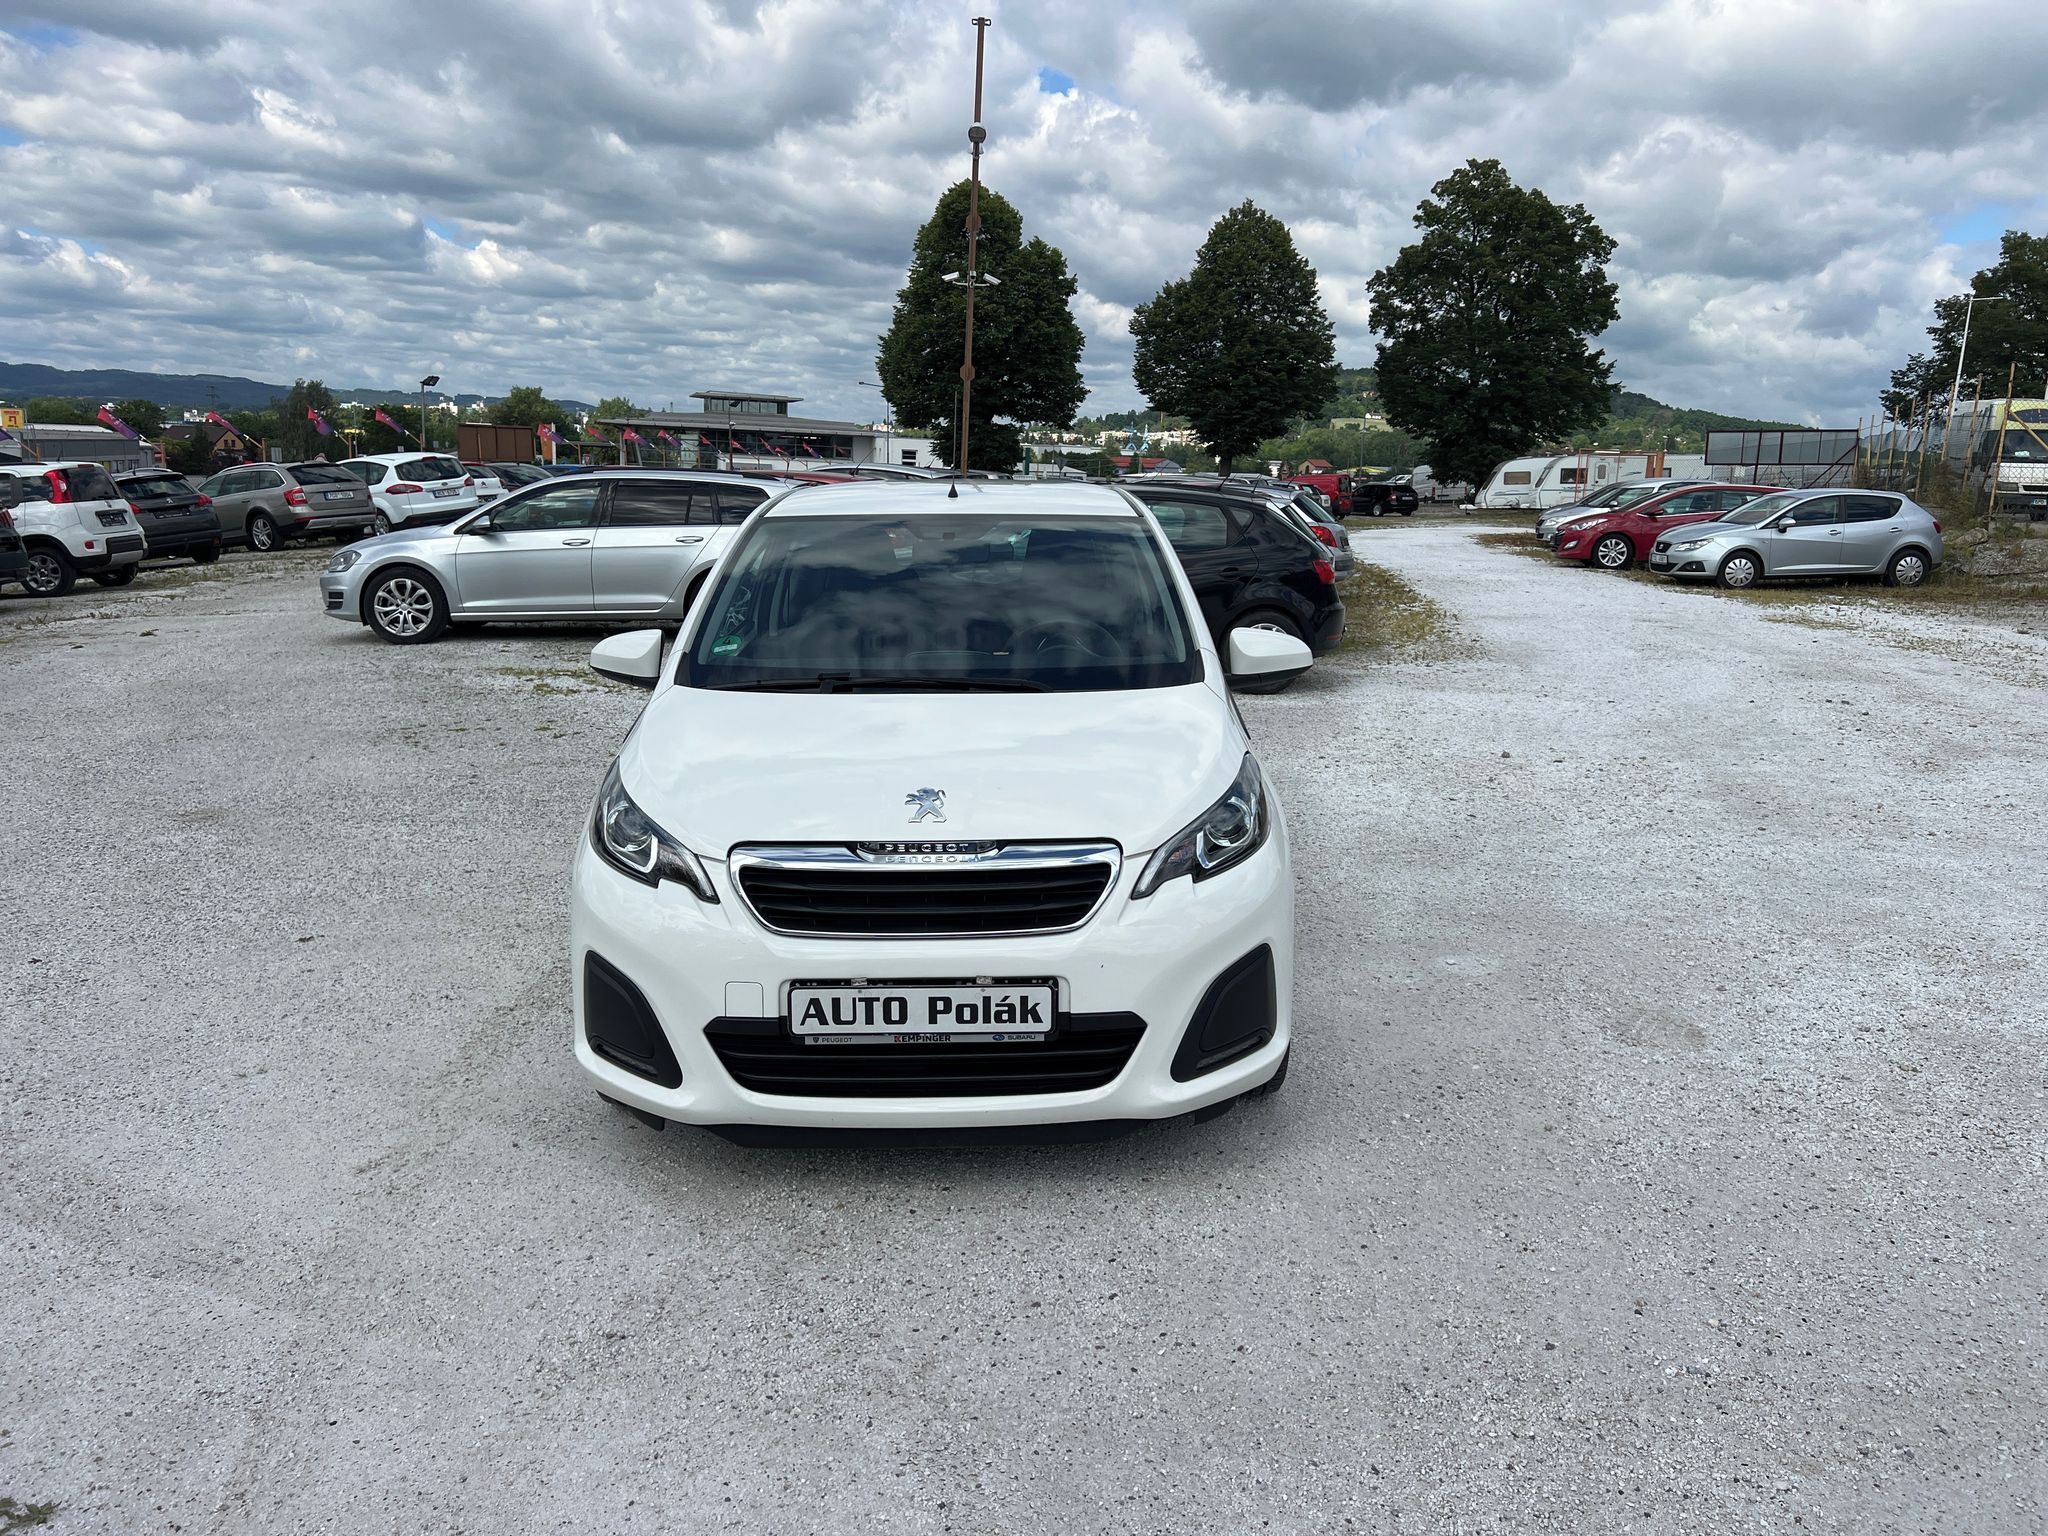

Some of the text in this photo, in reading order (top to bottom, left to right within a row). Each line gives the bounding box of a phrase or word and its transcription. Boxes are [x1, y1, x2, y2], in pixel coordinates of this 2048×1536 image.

[885, 843, 969, 852] PEUGEOT
[799, 995, 1044, 1026] AUTO Polák
[894, 1034, 952, 1043] KEMPINGER
